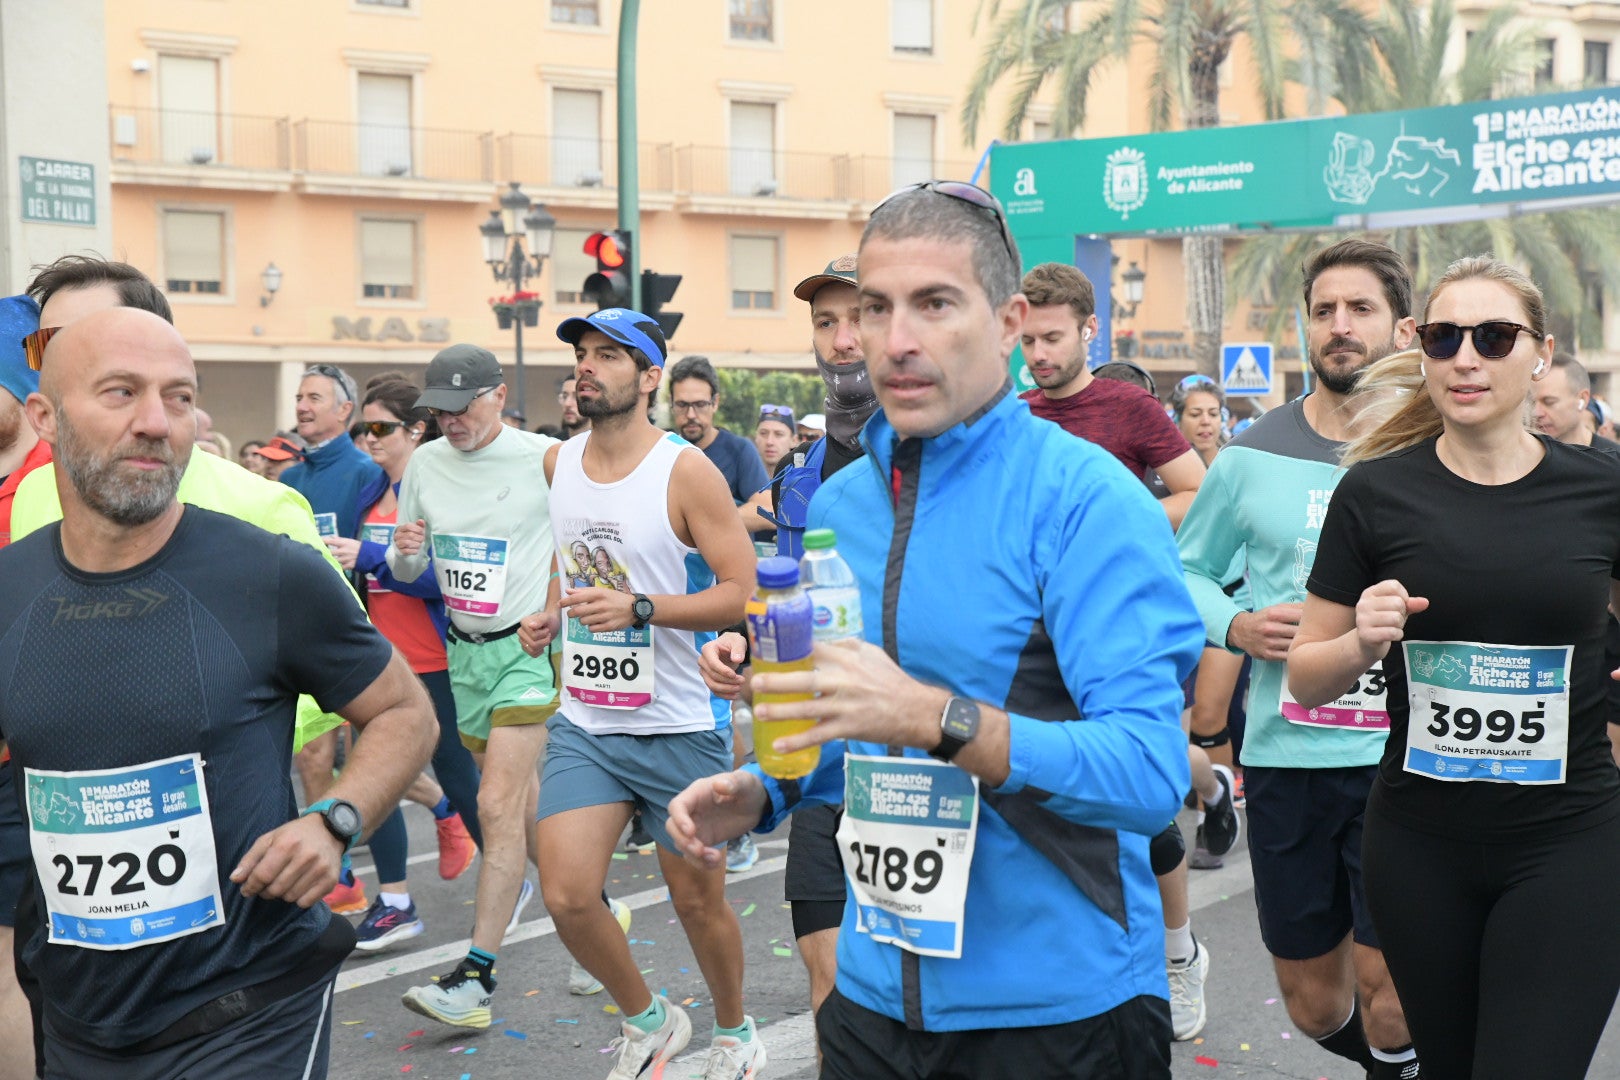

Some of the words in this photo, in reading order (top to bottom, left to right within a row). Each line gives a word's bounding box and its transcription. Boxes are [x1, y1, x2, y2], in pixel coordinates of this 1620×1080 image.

[1473, 137, 1570, 169] Elche
[36, 161, 91, 180] CARRER
[1157, 161, 1254, 182] Ayuntamiento
[1472, 158, 1620, 193] Alicante
[1167, 181, 1185, 194] de
[1187, 178, 1243, 193] Alicante
[28, 198, 50, 218] DEL
[54, 200, 91, 221] PALAU
[613, 537, 624, 545] SOL
[445, 569, 487, 592] 1162
[593, 634, 626, 643] Alicante
[573, 653, 639, 681] 2980
[1484, 655, 1530, 665] MARATÓN
[1470, 665, 1508, 679] Elche
[1509, 671, 1530, 680] 42K
[1469, 676, 1530, 689] Alicante
[1427, 701, 1545, 744] 3995
[1435, 744, 1460, 754] ILONA
[1463, 747, 1532, 757] PETRAUSKAITE
[94, 779, 150, 797] MARATÓN
[882, 773, 933, 787] MARATÓN
[94, 789, 151, 801] INTERNACIONAL
[162, 793, 168, 803] El
[170, 791, 185, 802] gran
[871, 788, 905, 804] Elche
[906, 794, 930, 806] 42K
[82, 799, 125, 814] Elche
[126, 796, 153, 810] 42K
[870, 801, 929, 818] Alicante
[84, 807, 154, 826] Alicante
[52, 843, 186, 897] 2720
[850, 841, 943, 894] 2789
[88, 906, 112, 914] JOAN
[114, 901, 150, 913] MELIA
